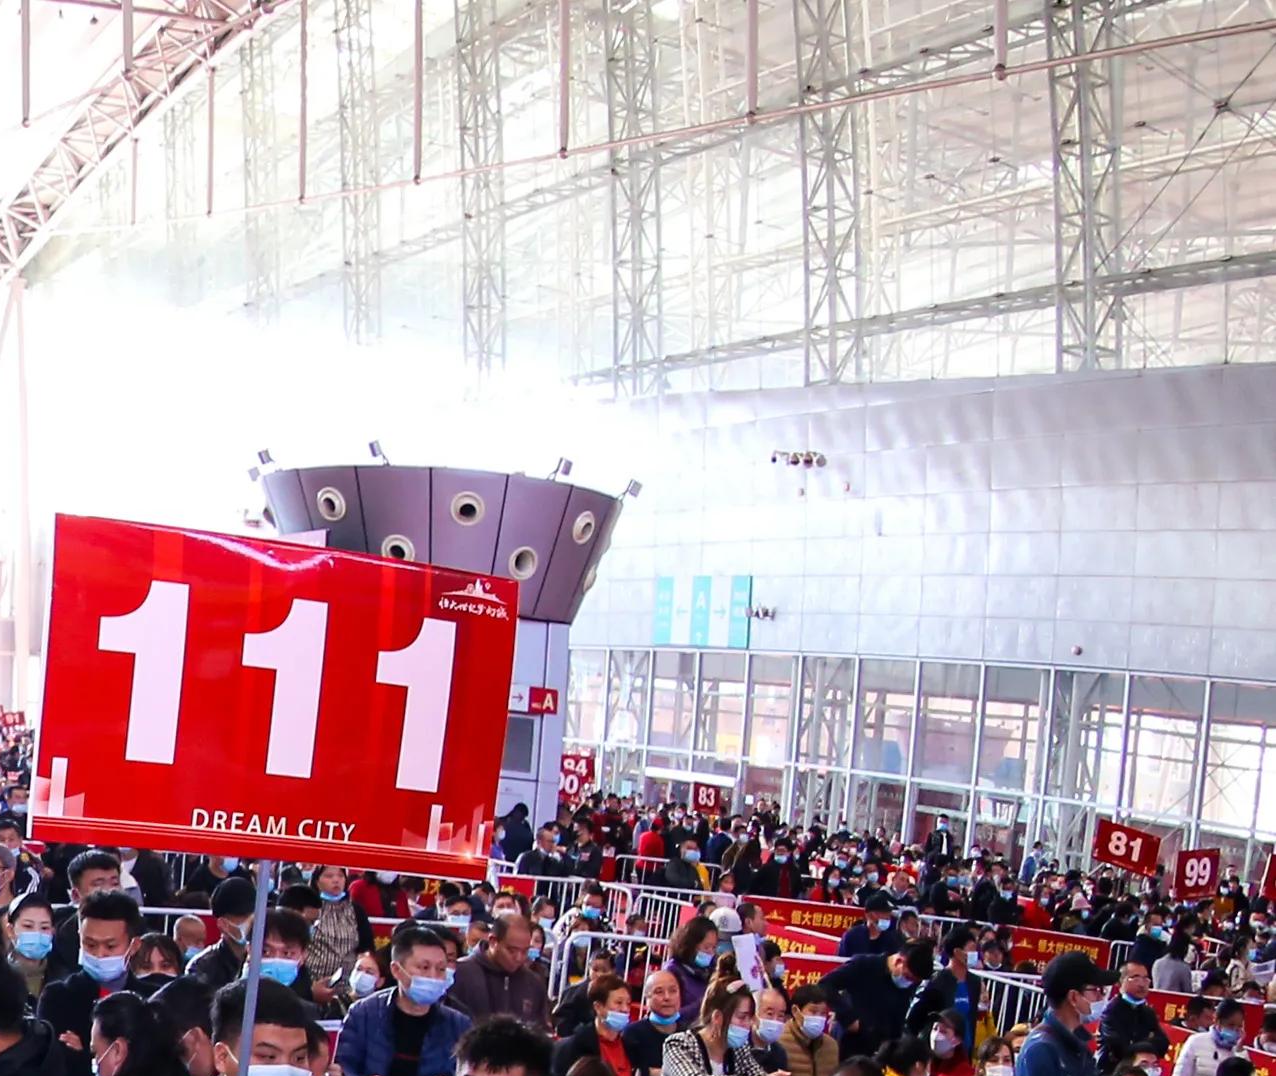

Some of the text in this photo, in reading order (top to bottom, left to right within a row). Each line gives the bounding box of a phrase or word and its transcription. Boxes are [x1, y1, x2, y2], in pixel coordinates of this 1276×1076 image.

[97, 579, 457, 793] 111
[542, 693, 554, 711] A
[699, 786, 715, 806] 83
[192, 808, 356, 842] DREAM CITY
[1108, 831, 1143, 862] 81
[1184, 856, 1211, 887] 99
